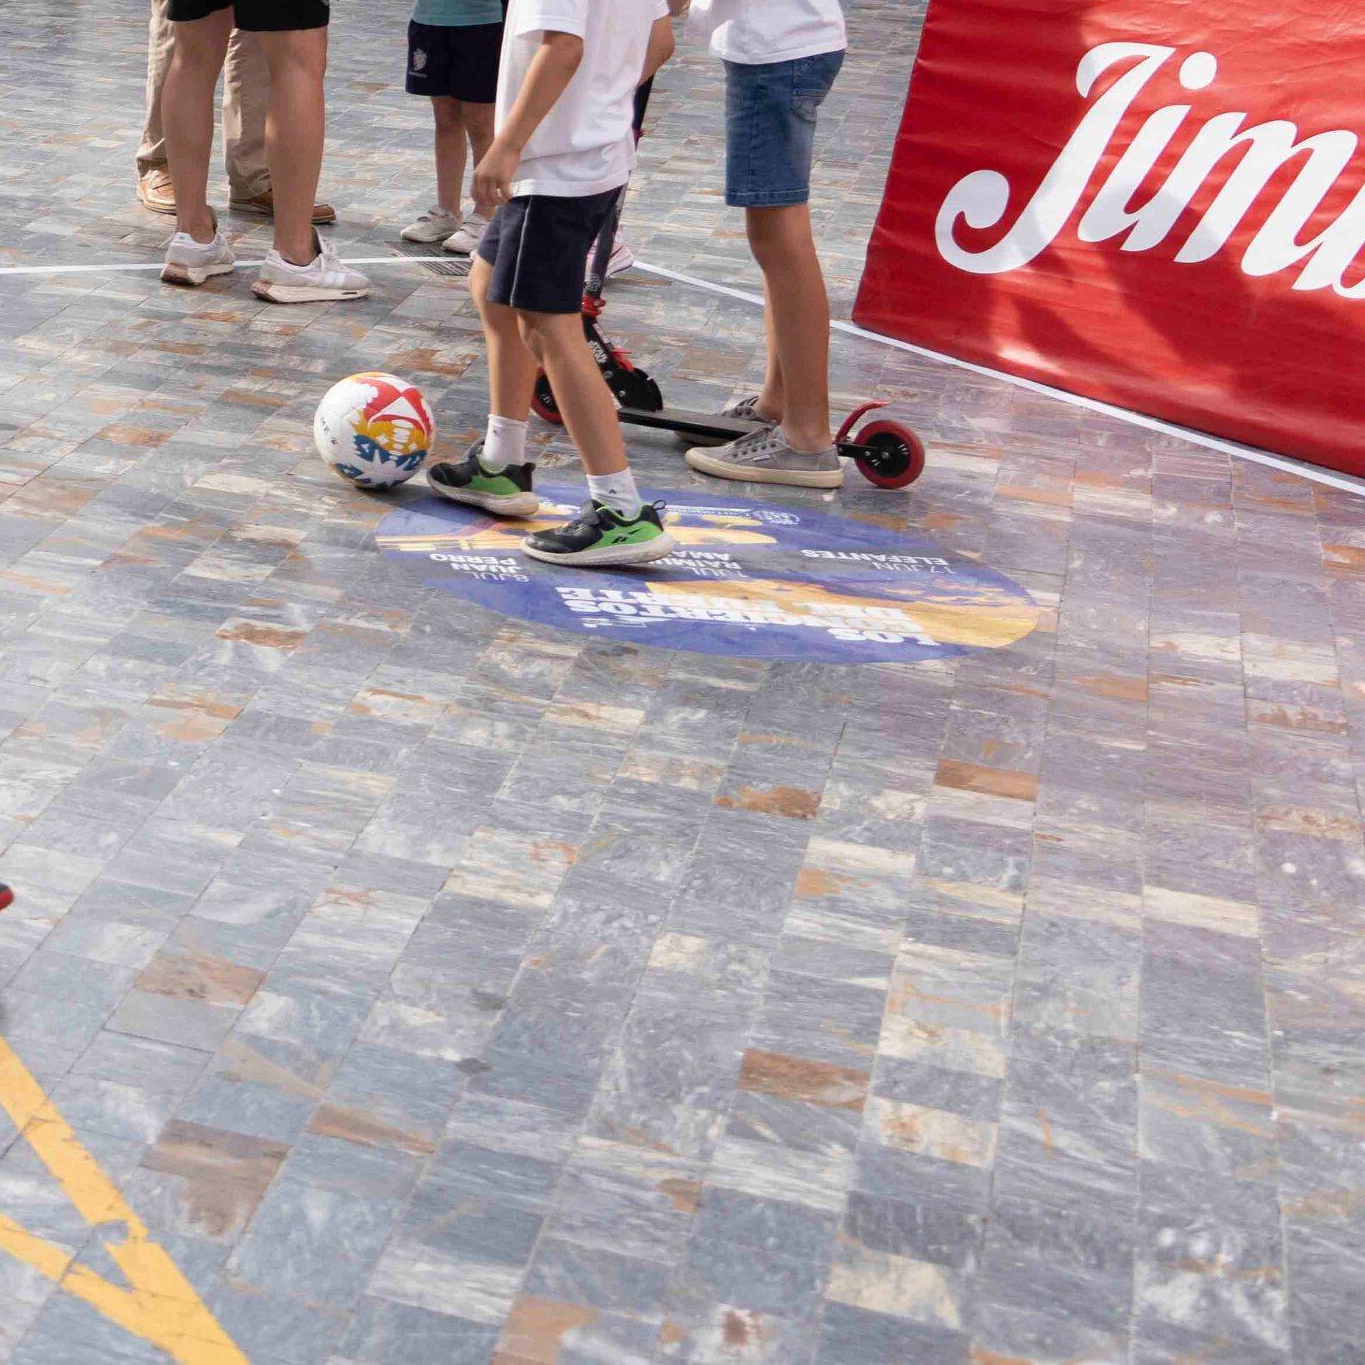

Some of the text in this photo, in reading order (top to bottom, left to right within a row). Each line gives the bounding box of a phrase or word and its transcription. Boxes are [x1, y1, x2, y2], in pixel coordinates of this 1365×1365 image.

[429, 553, 517, 566] PERRO
[802, 548, 949, 566] ELEFANTES
[450, 562, 522, 573] JUAN
[826, 627, 942, 646] LOS
